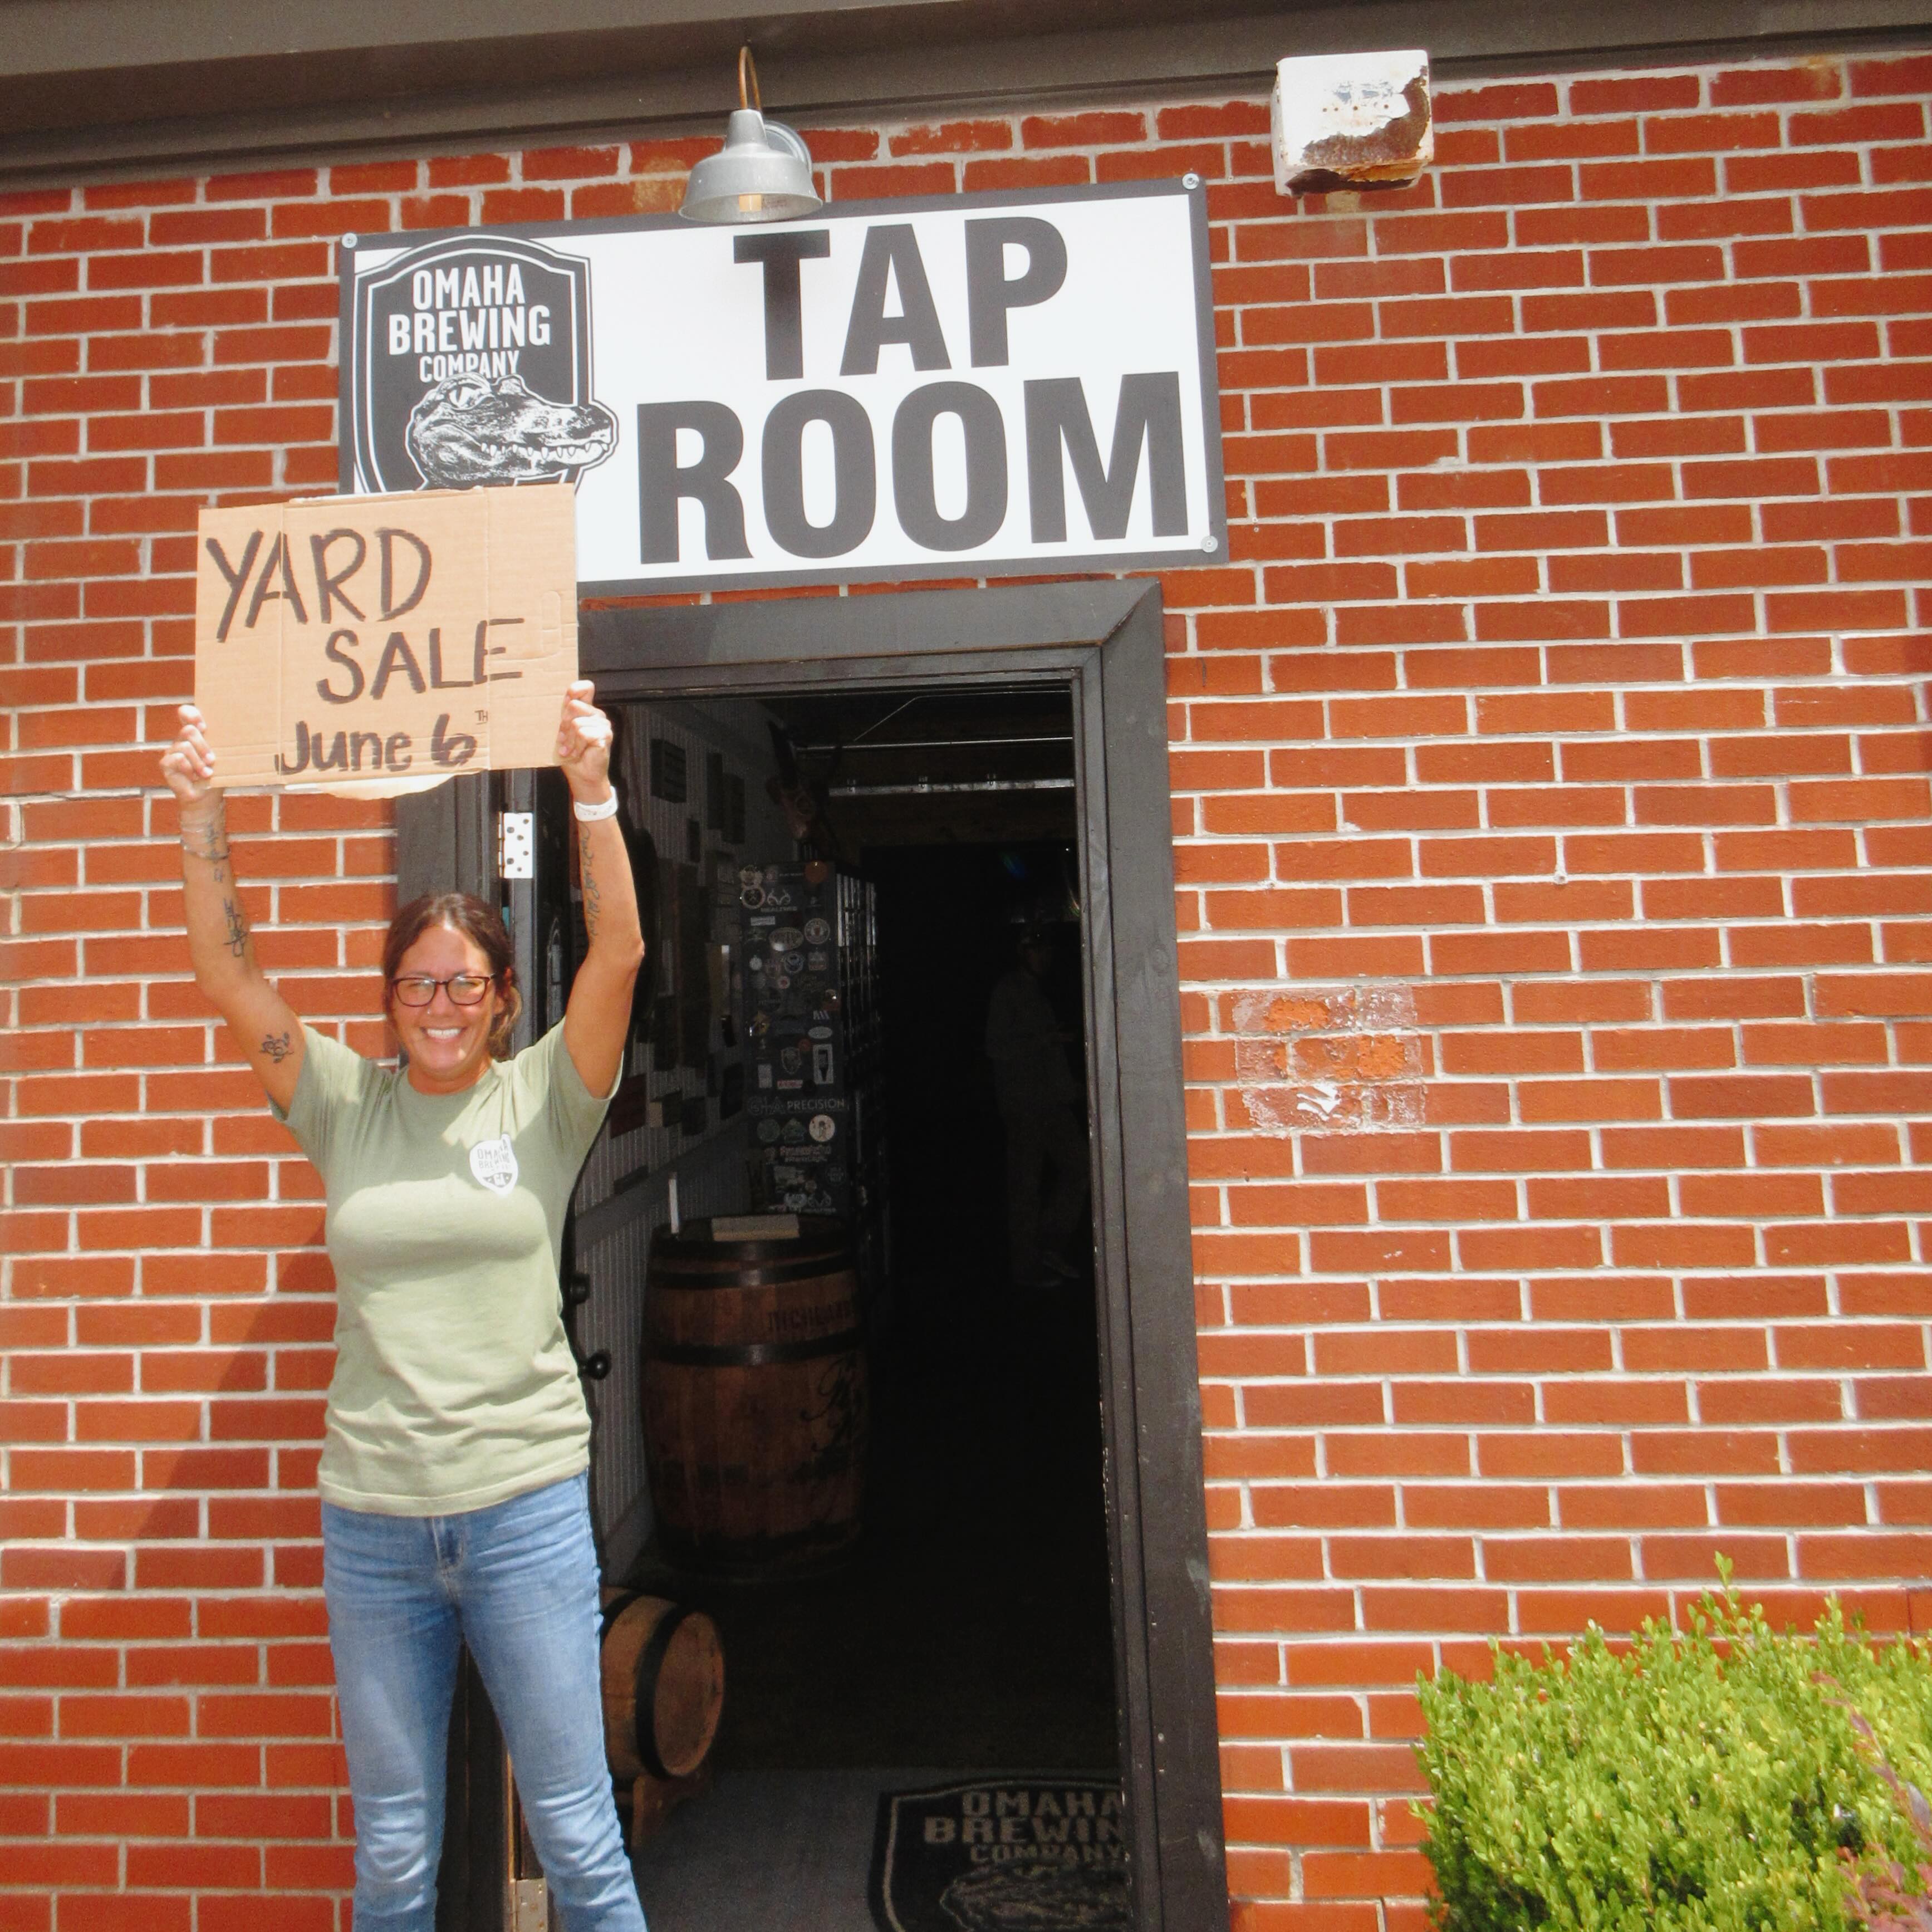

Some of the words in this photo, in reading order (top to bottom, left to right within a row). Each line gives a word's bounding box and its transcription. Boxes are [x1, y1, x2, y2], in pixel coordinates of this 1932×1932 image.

[413, 263, 526, 311] OMAHA
[733, 217, 1067, 381] TAP
[389, 306, 551, 355] BREWING
[419, 350, 520, 383] COMPANY
[636, 371, 1189, 565] ROOM
[205, 528, 432, 644] YARD
[316, 617, 524, 704] SALE
[274, 720, 413, 776] June
[787, 1098, 845, 1110] PRECISION
